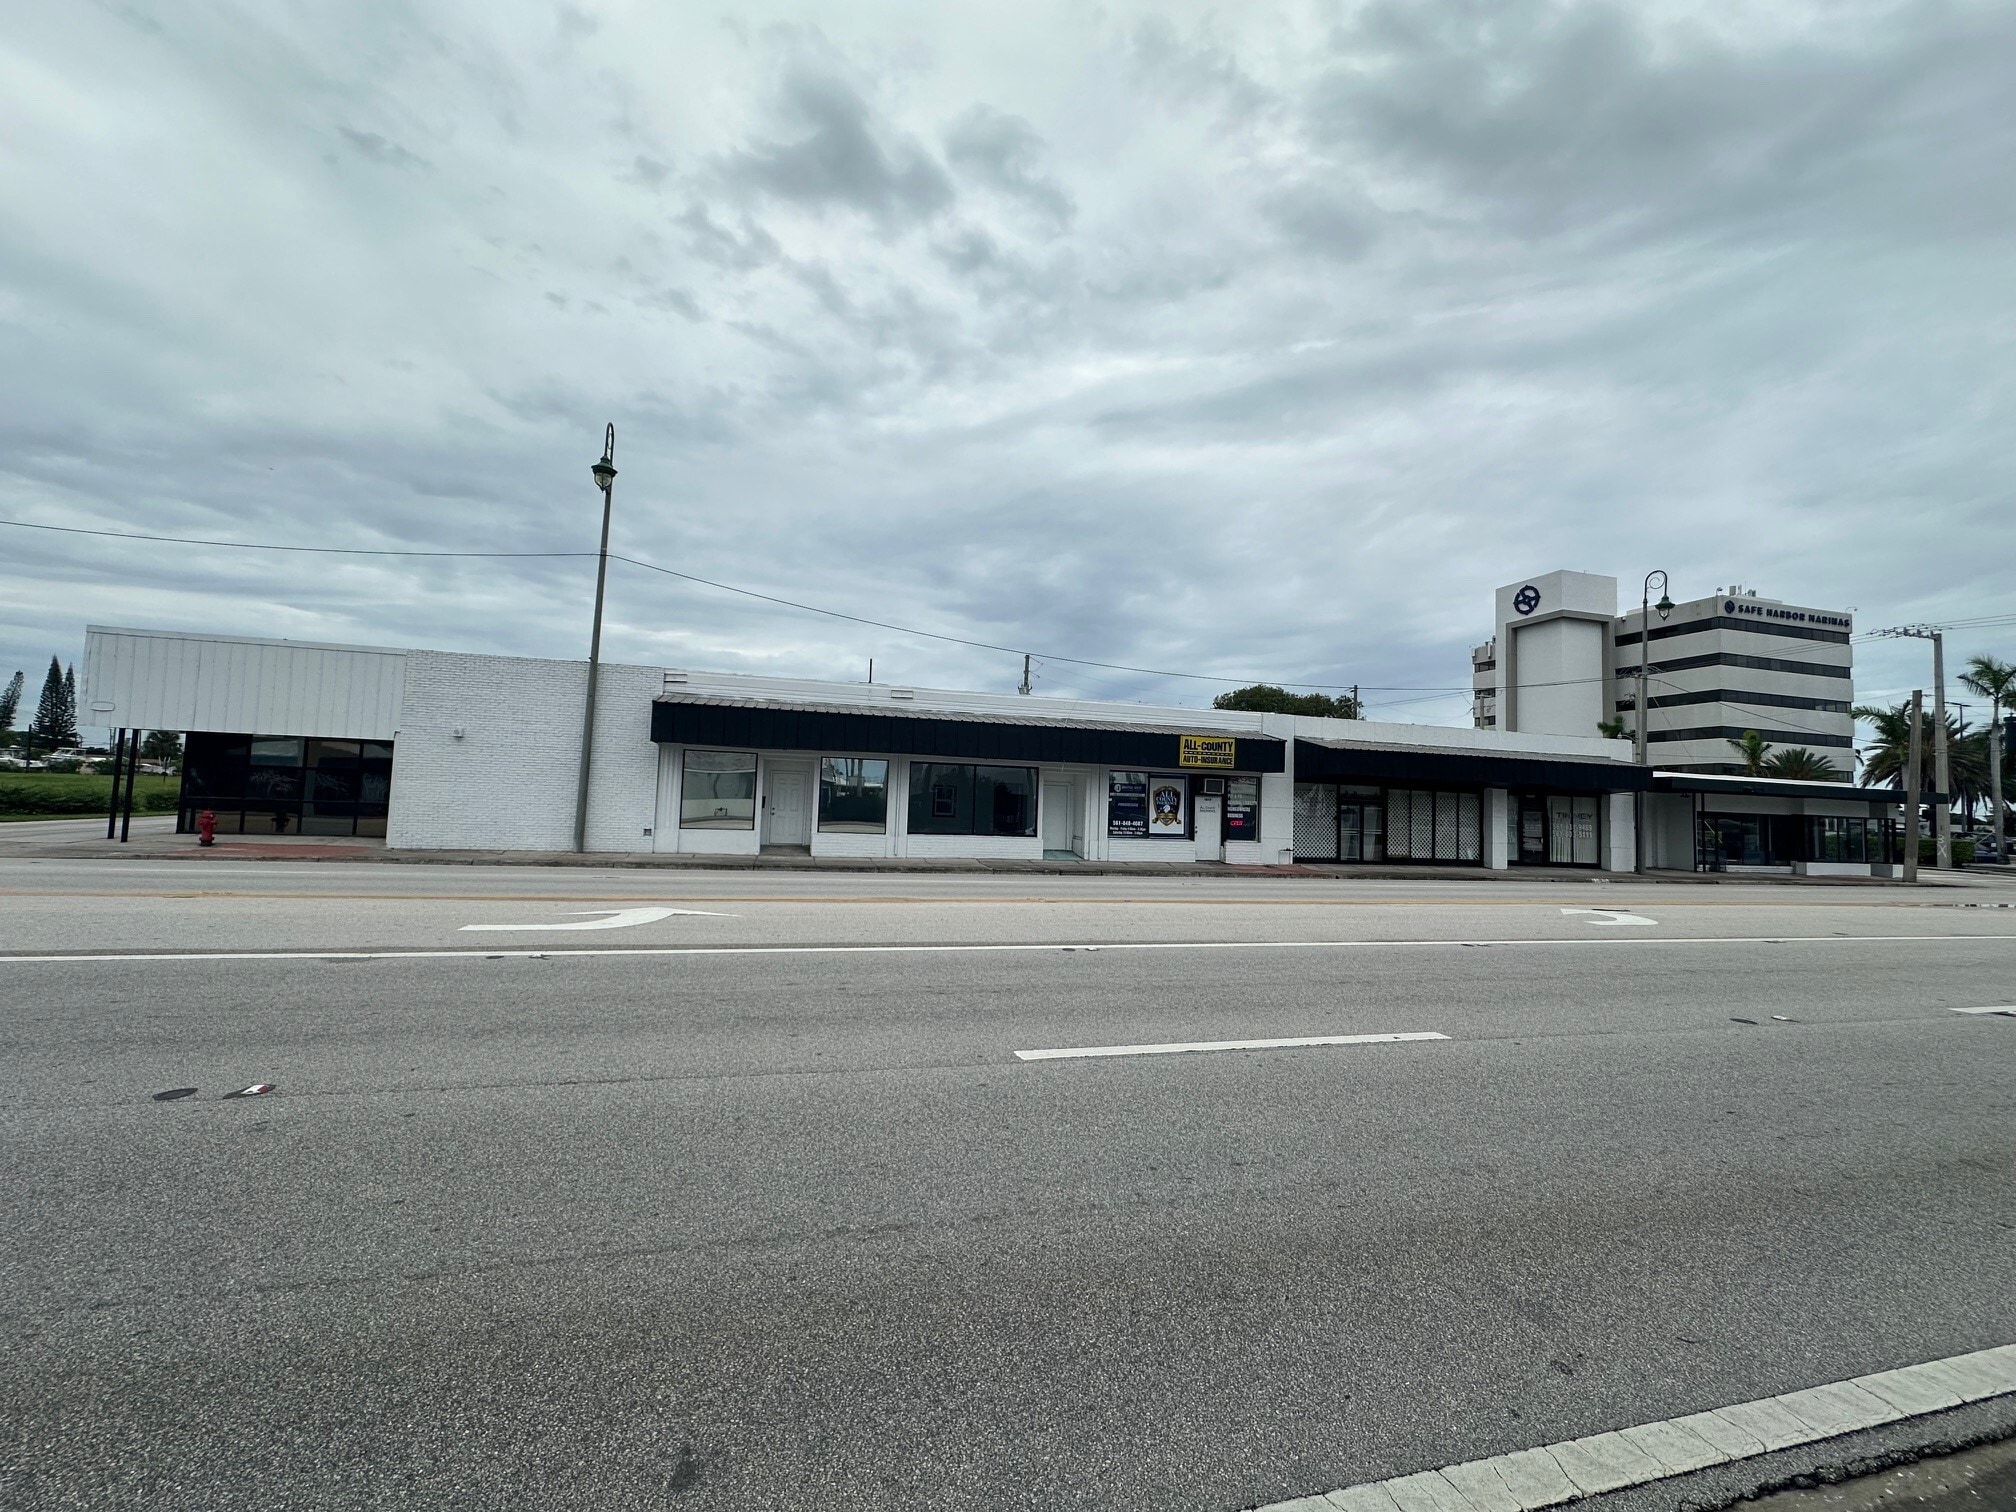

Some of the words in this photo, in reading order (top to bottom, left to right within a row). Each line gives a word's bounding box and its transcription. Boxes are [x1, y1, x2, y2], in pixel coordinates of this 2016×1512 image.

[1738, 604, 1763, 616] SAFE
[1766, 608, 1806, 622] HARBOR
[1808, 614, 1850, 628] MARINAS
[1184, 739, 1233, 752] ALL-COUNTY
[1183, 755, 1233, 765] AUTO-INSURANCE
